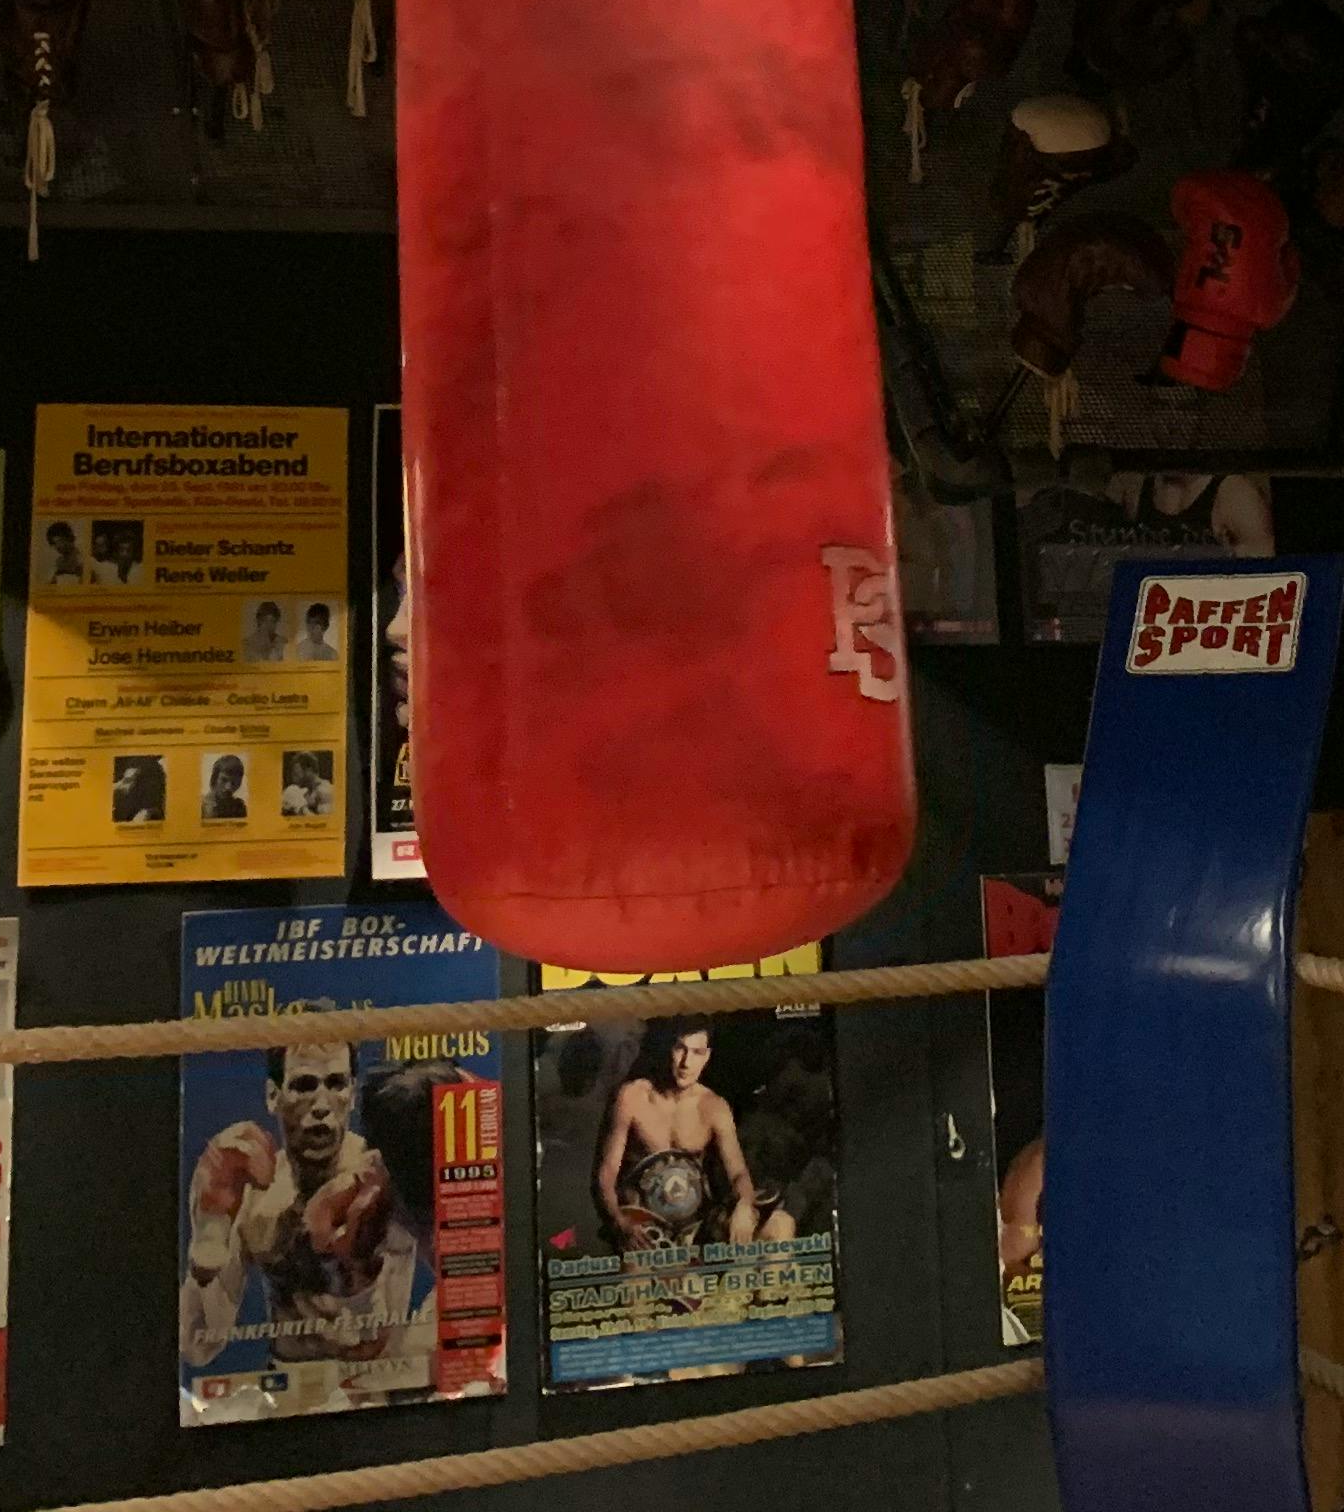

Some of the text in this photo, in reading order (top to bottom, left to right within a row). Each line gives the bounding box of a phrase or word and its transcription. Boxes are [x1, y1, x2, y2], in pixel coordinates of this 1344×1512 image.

[87, 423, 299, 450] Internationaler
[73, 451, 309, 477] Berufsboxabend
[156, 539, 296, 557] Dieter Schantz
[156, 566, 269, 583] René Weller
[1143, 580, 1298, 625] PAFFEN
[87, 620, 140, 638] Erwin
[88, 646, 236, 665] Jose Hernandez
[1133, 623, 1291, 667] SPORT
[276, 915, 406, 940] IBF BOX-
[443, 1164, 496, 1181] 1995
[548, 1255, 621, 1279] Dariusz
[703, 1231, 832, 1262] Michalczewski
[549, 1265, 833, 1311] STADTHALLE BREMEN
